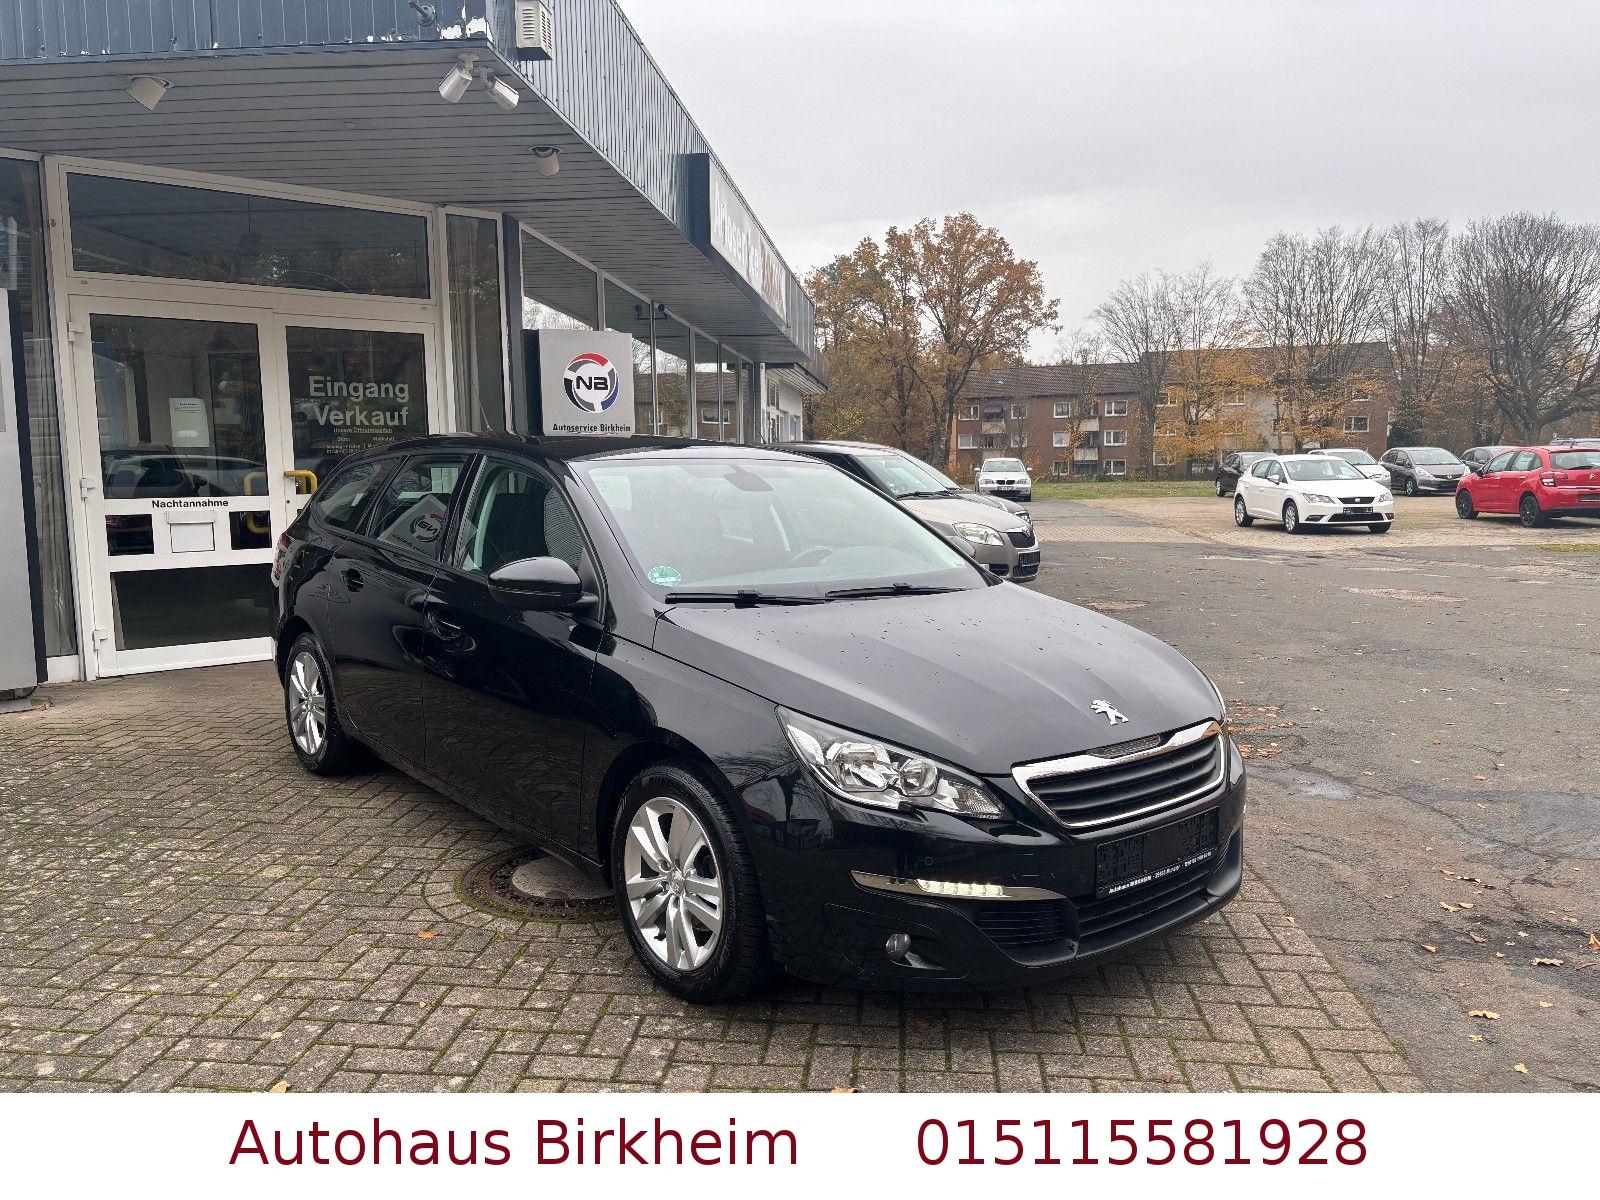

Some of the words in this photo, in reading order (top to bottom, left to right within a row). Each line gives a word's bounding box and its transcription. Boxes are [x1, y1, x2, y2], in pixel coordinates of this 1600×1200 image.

[308, 375, 410, 403] Eingang
[576, 375, 609, 391] NB
[313, 405, 409, 426] Verkauf
[552, 423, 598, 432] Autoservice
[600, 423, 631, 432] Birkheim
[152, 498, 229, 509] Nachtannahme
